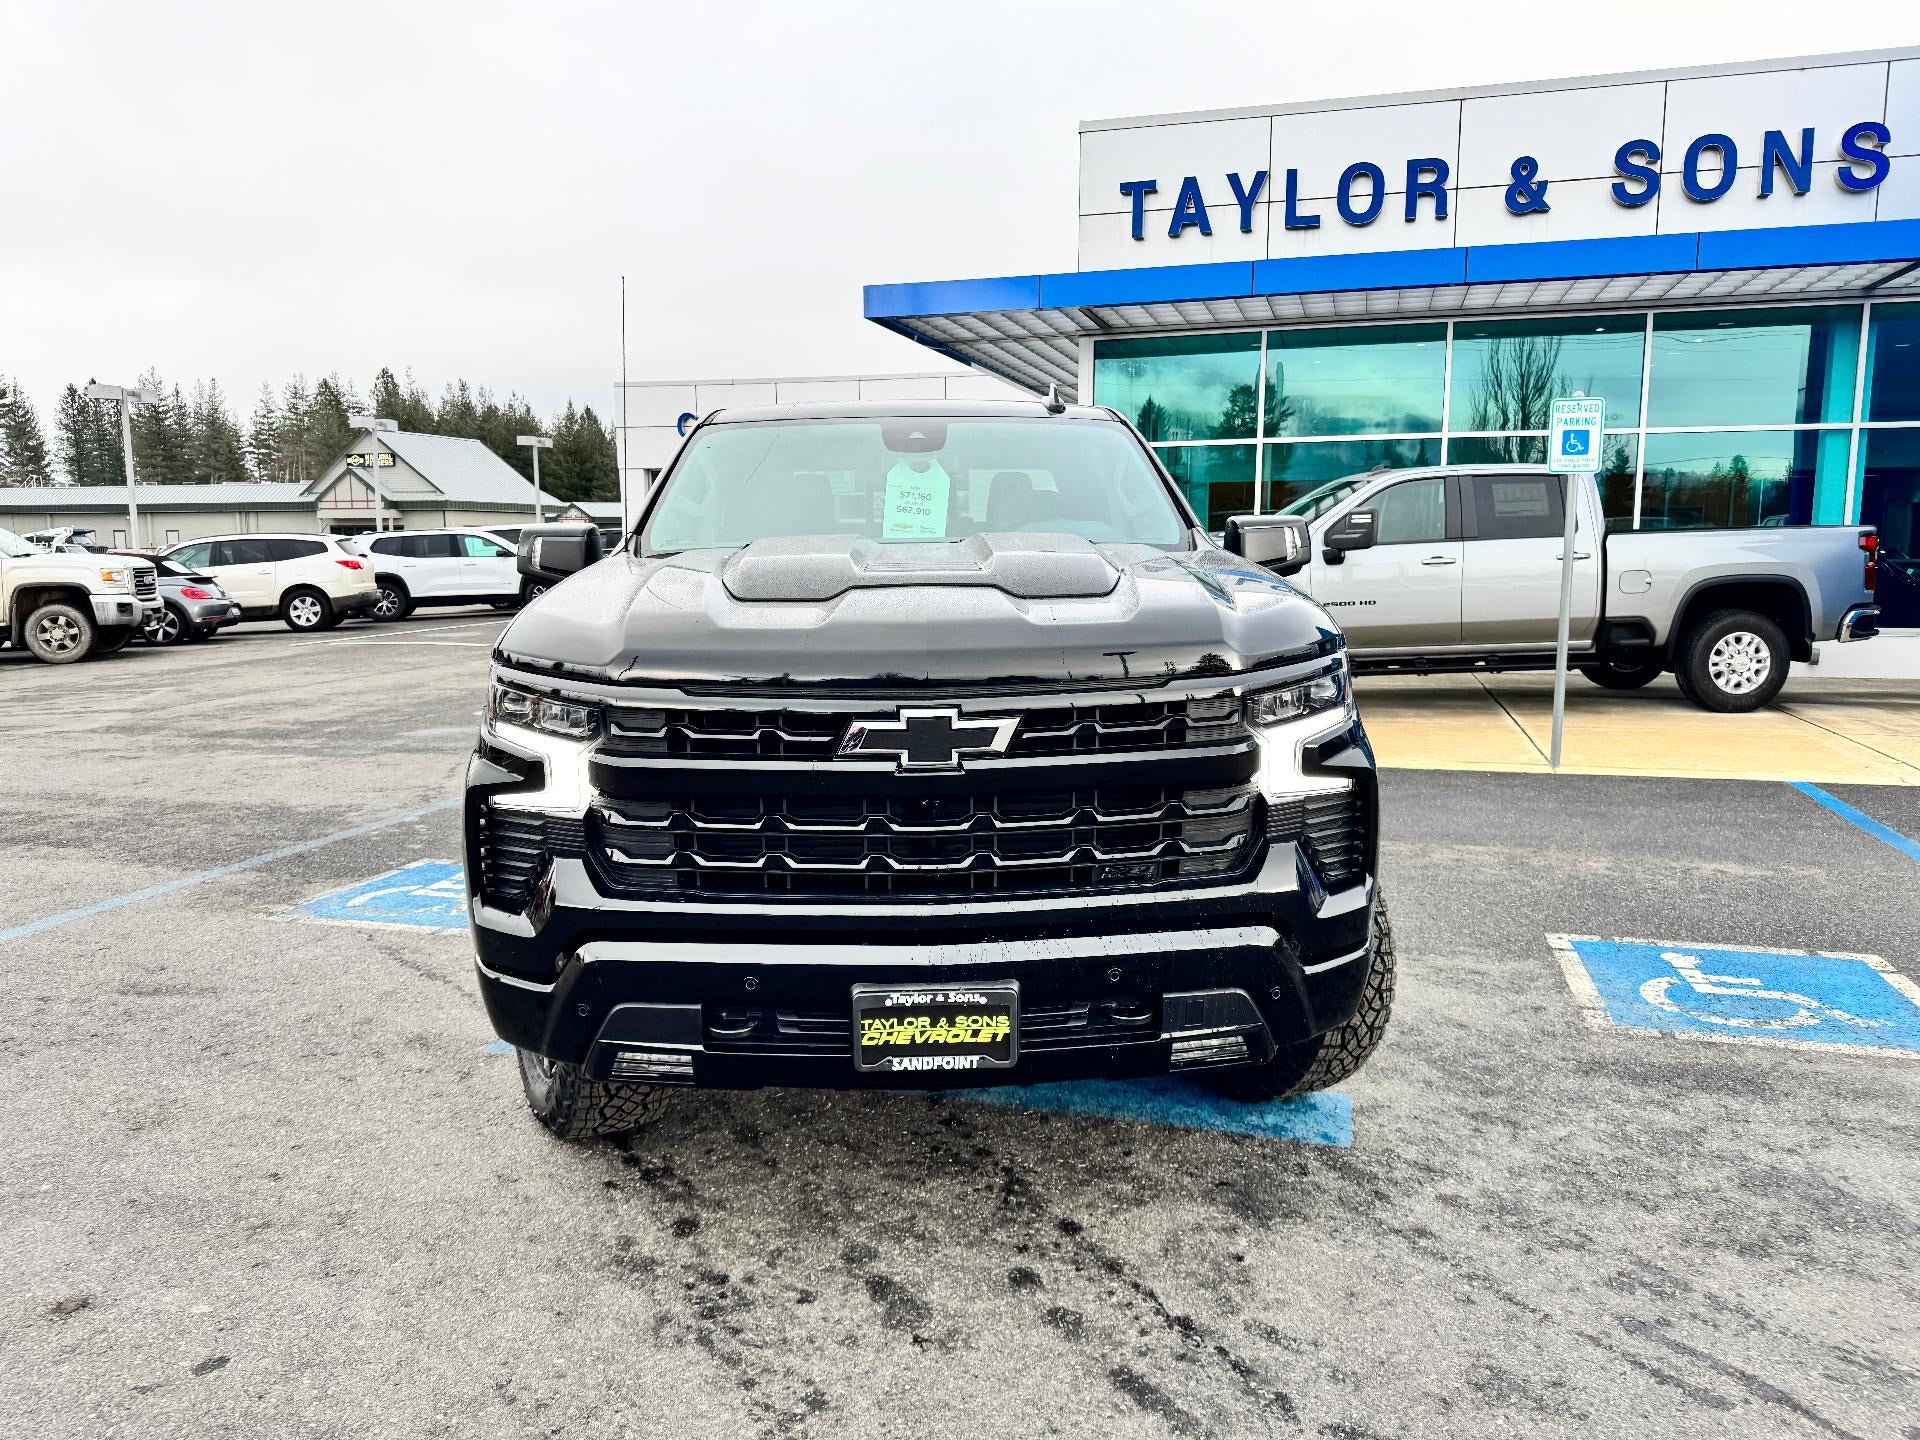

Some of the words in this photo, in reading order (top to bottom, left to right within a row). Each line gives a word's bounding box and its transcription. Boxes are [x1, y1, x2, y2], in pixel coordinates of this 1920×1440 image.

[1120, 158, 1449, 241] TAYLOR
[1504, 155, 1551, 216] &
[1610, 121, 1891, 209] SONS
[1555, 403, 1600, 414] RESERVED
[1556, 416, 1597, 427] PARKING
[899, 491, 932, 502] $71,160
[896, 505, 931, 516] $62,910
[891, 993, 933, 1006] Taylor
[948, 993, 980, 1003] Sons
[861, 1017, 931, 1031] TAYLOR
[936, 1017, 949, 1028] &
[955, 1015, 1010, 1028] SONS
[861, 1028, 1011, 1046] CHEVROLET
[891, 1056, 979, 1071] SANDPOINT
